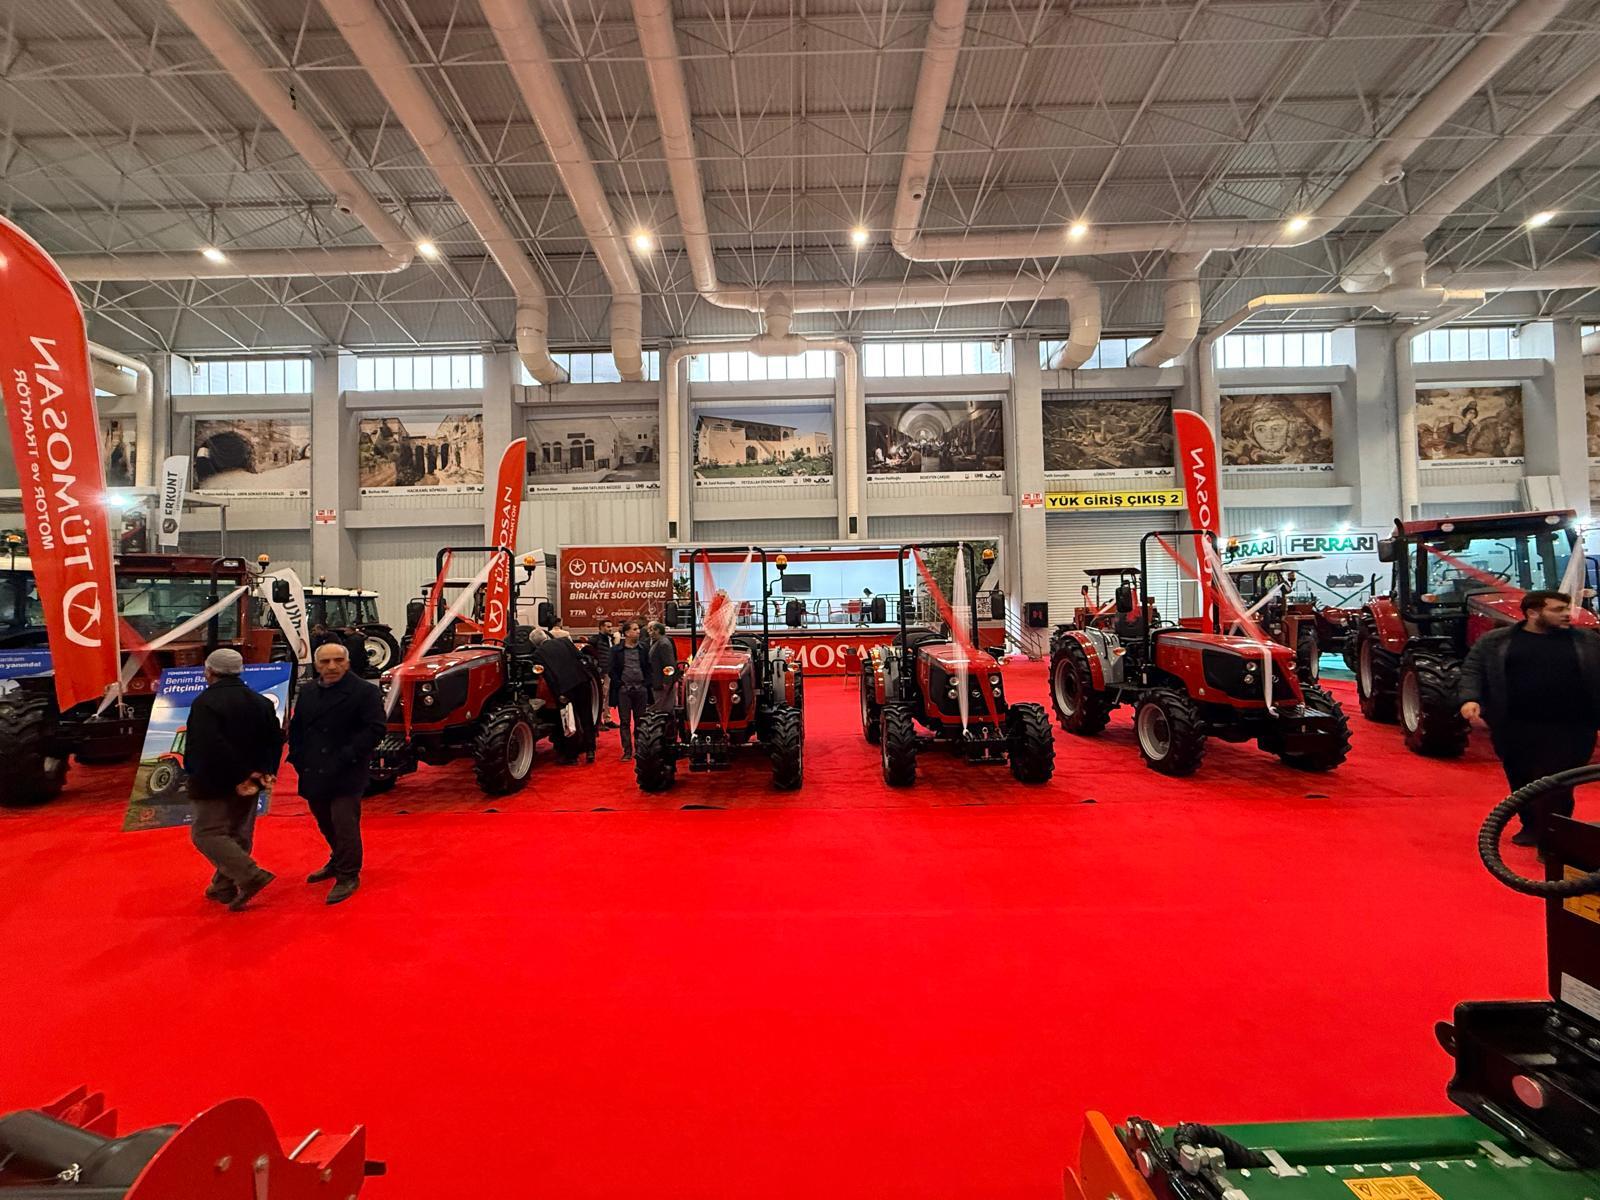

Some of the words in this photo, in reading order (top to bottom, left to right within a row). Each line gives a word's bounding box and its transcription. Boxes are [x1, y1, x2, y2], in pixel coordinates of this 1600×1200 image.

[165, 471, 178, 516] ERKUNT
[1049, 495, 1079, 506] YÜK
[1084, 494, 1123, 507] GİRİŞ
[1127, 494, 1166, 507] ÇIKIŞ
[1170, 494, 1179, 503] 2
[1291, 536, 1374, 552] FERRARI
[589, 559, 666, 574] TÜMOSAN
[569, 579, 615, 590] TOPRAĞIN
[616, 578, 669, 589] HİKAYESİNİ
[569, 590, 610, 600] BİRLİKTE
[610, 590, 666, 600] SÜRÜYORUZ
[165, 677, 194, 685] Benim
[163, 684, 204, 695] çiftçinin
